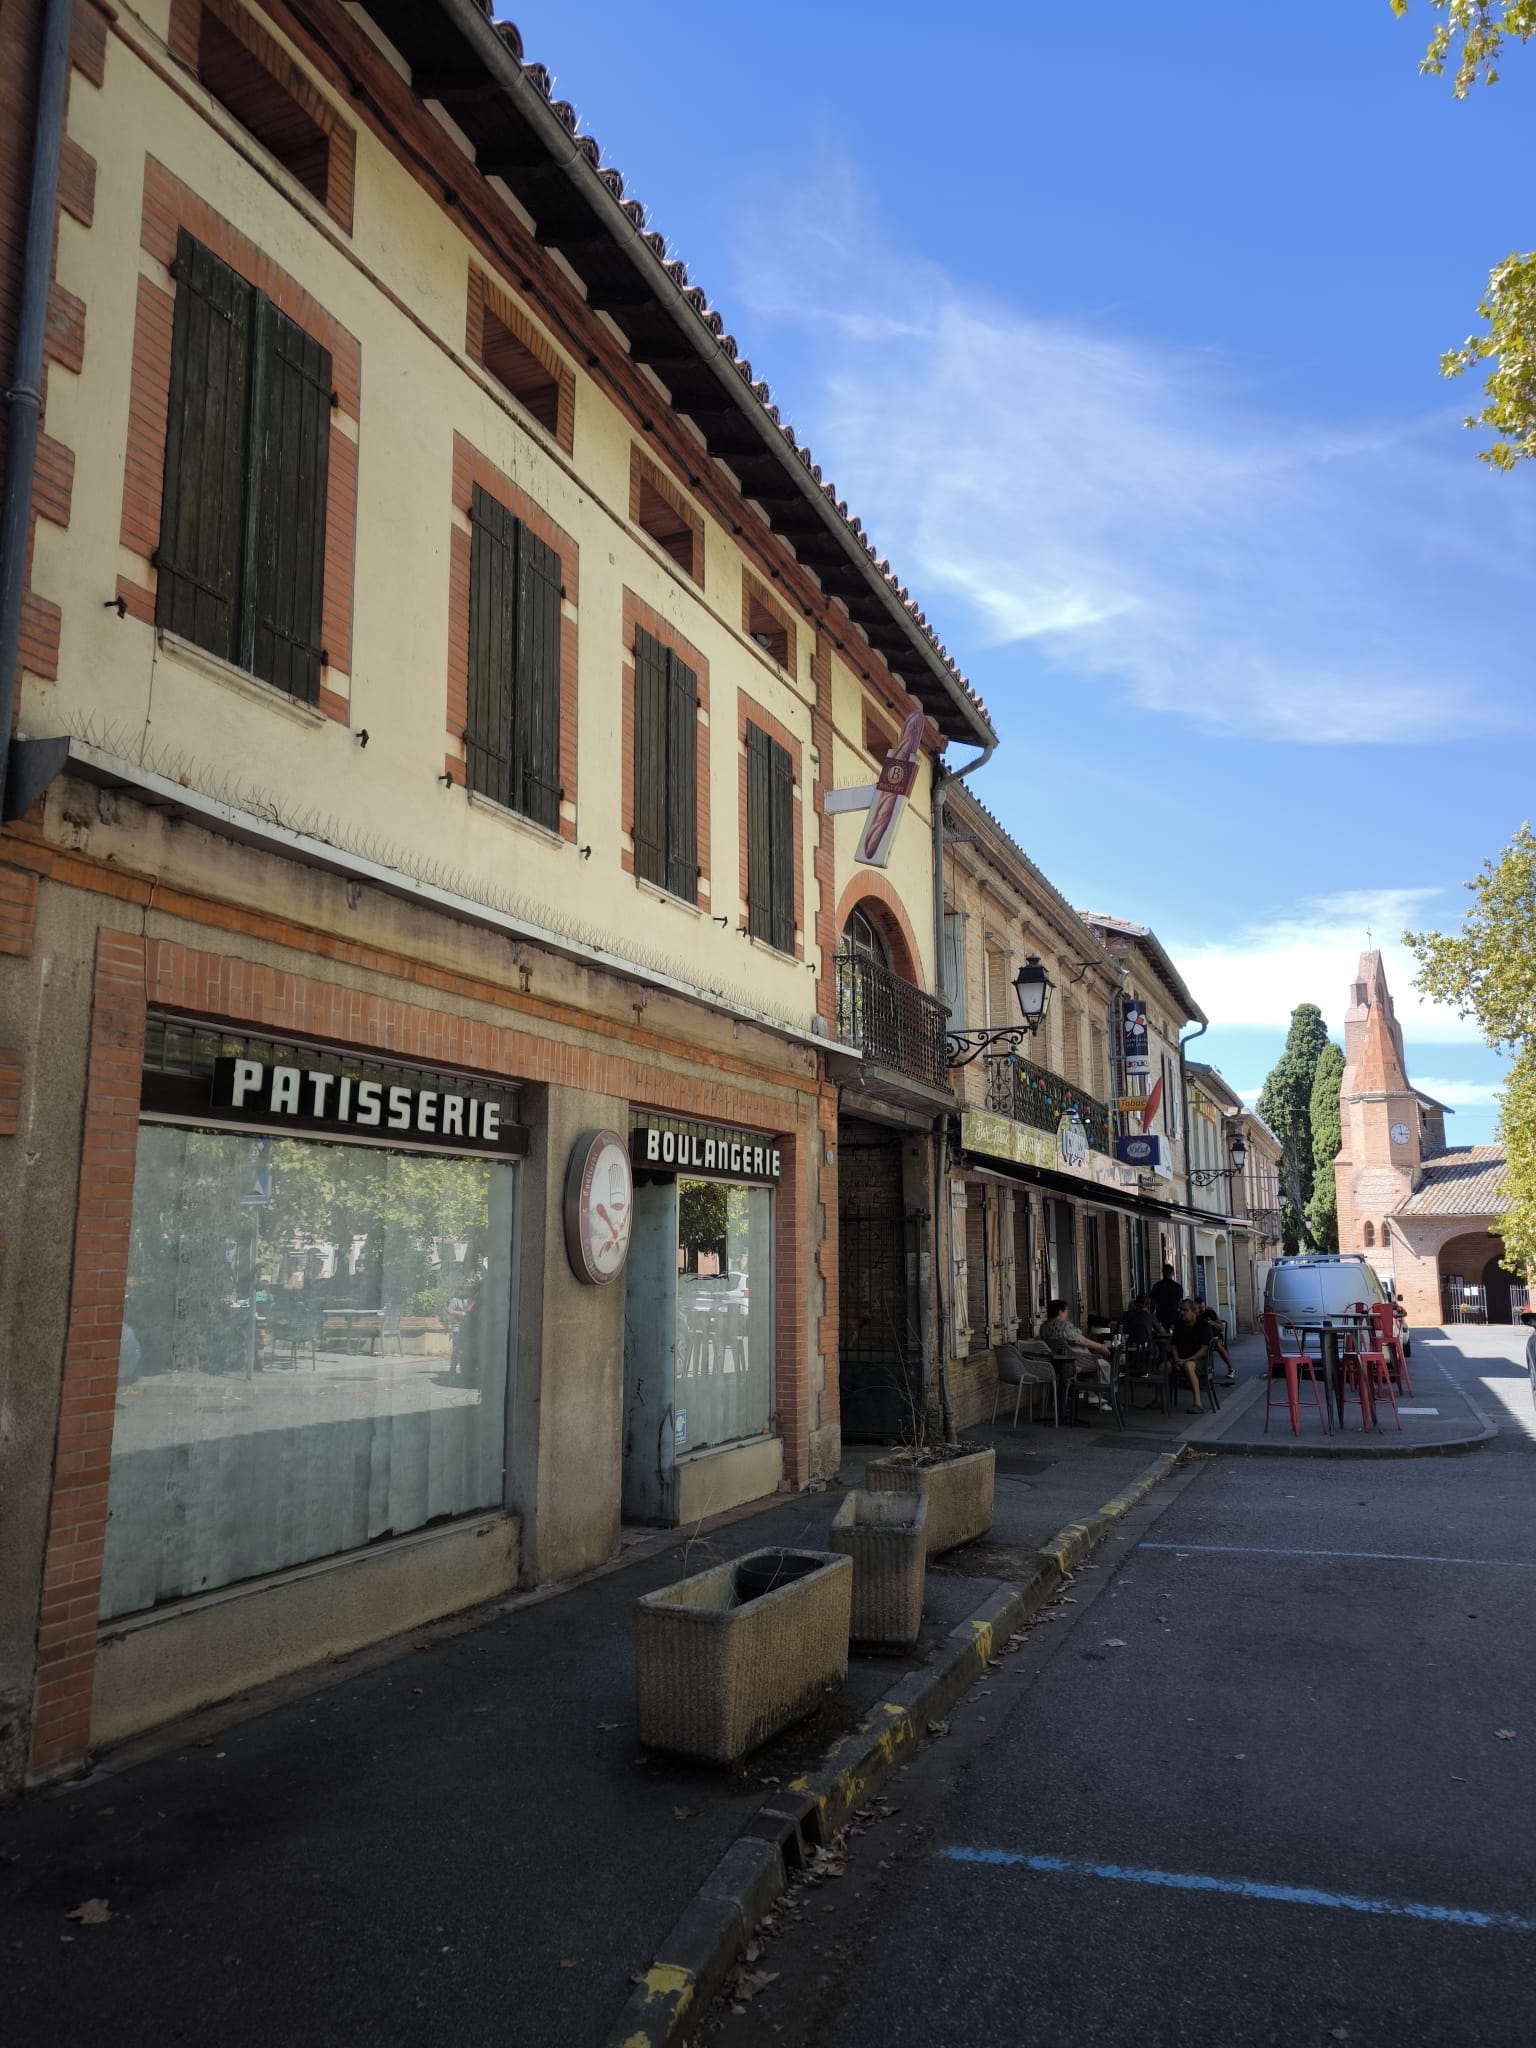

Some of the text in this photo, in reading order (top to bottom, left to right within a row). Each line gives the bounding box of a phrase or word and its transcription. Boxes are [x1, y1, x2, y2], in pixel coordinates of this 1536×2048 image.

[231, 1057, 502, 1141] PATISSERIE
[1121, 1099, 1146, 1107] Tabac
[646, 1129, 781, 1177] BOULANGERIE
